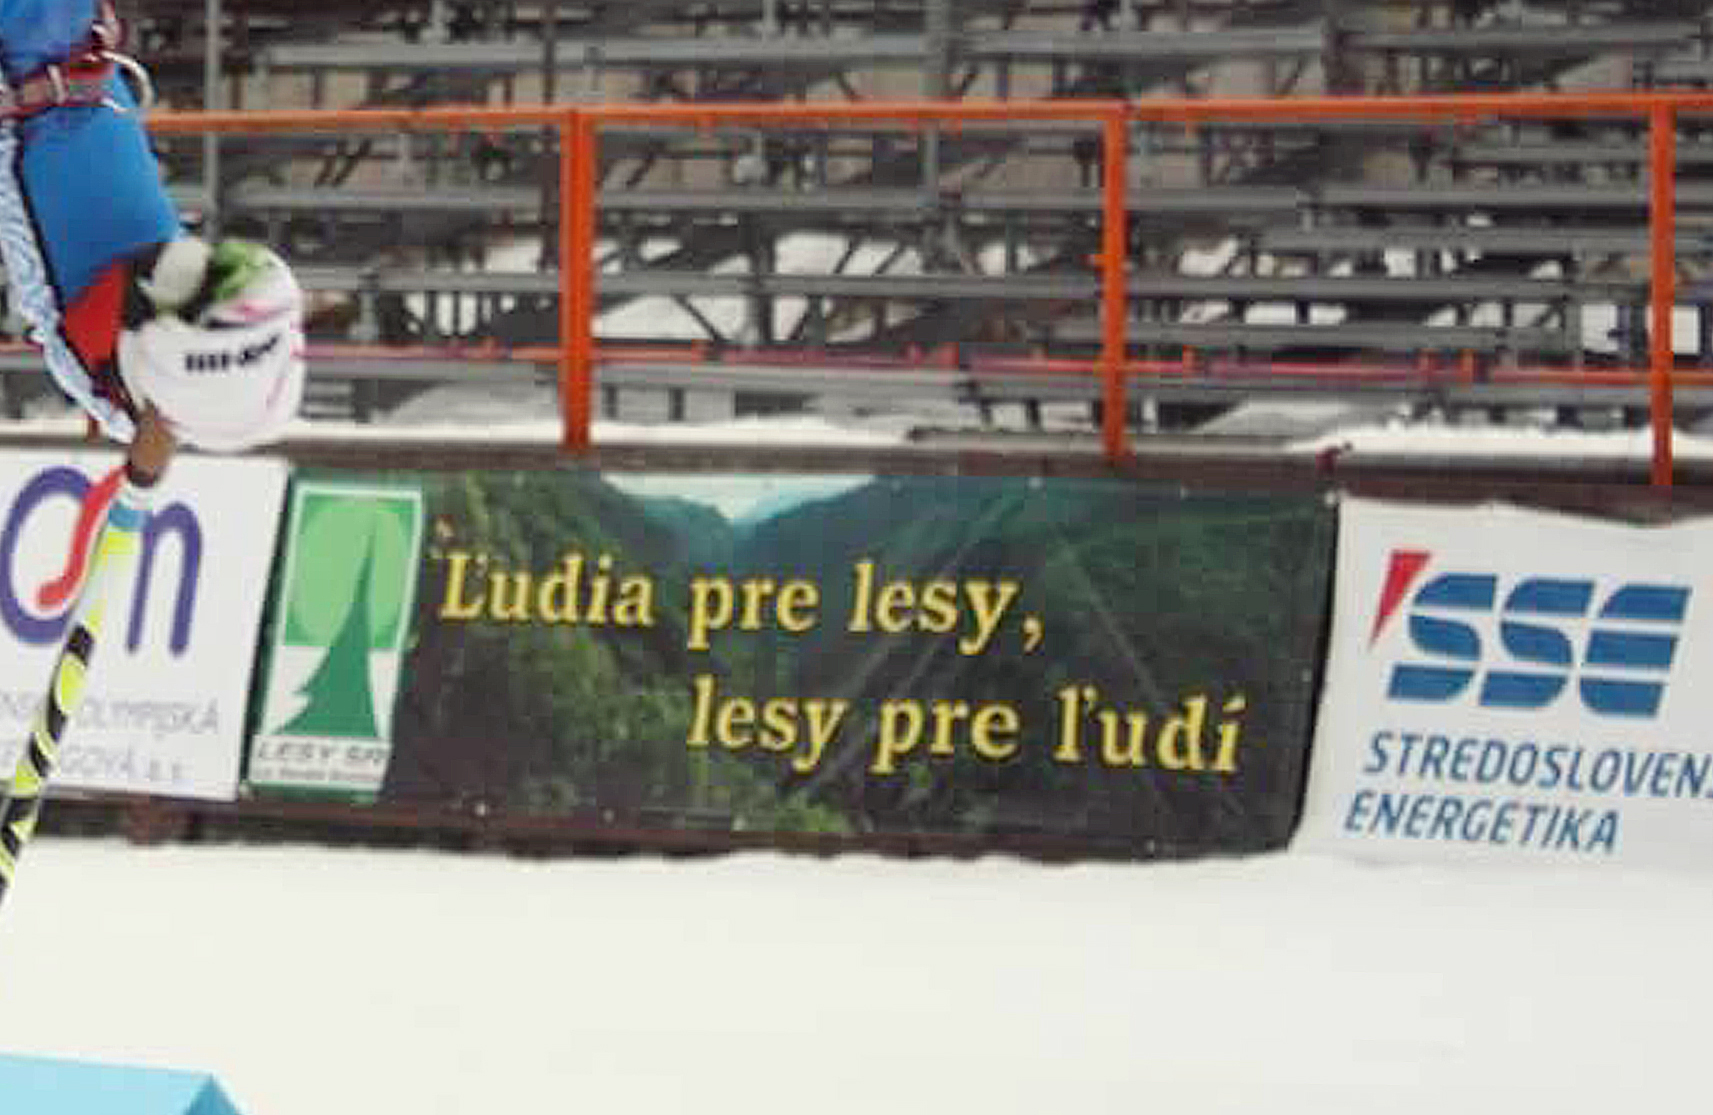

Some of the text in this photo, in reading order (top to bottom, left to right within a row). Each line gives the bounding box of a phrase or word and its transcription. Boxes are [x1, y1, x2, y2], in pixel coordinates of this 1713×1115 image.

[439, 551, 1045, 657] Ľudia pre lesy,
[1387, 572, 1693, 719] SSE
[685, 673, 1248, 774] lesy pre ľudí
[1343, 790, 1623, 855] ENERGETIKA
